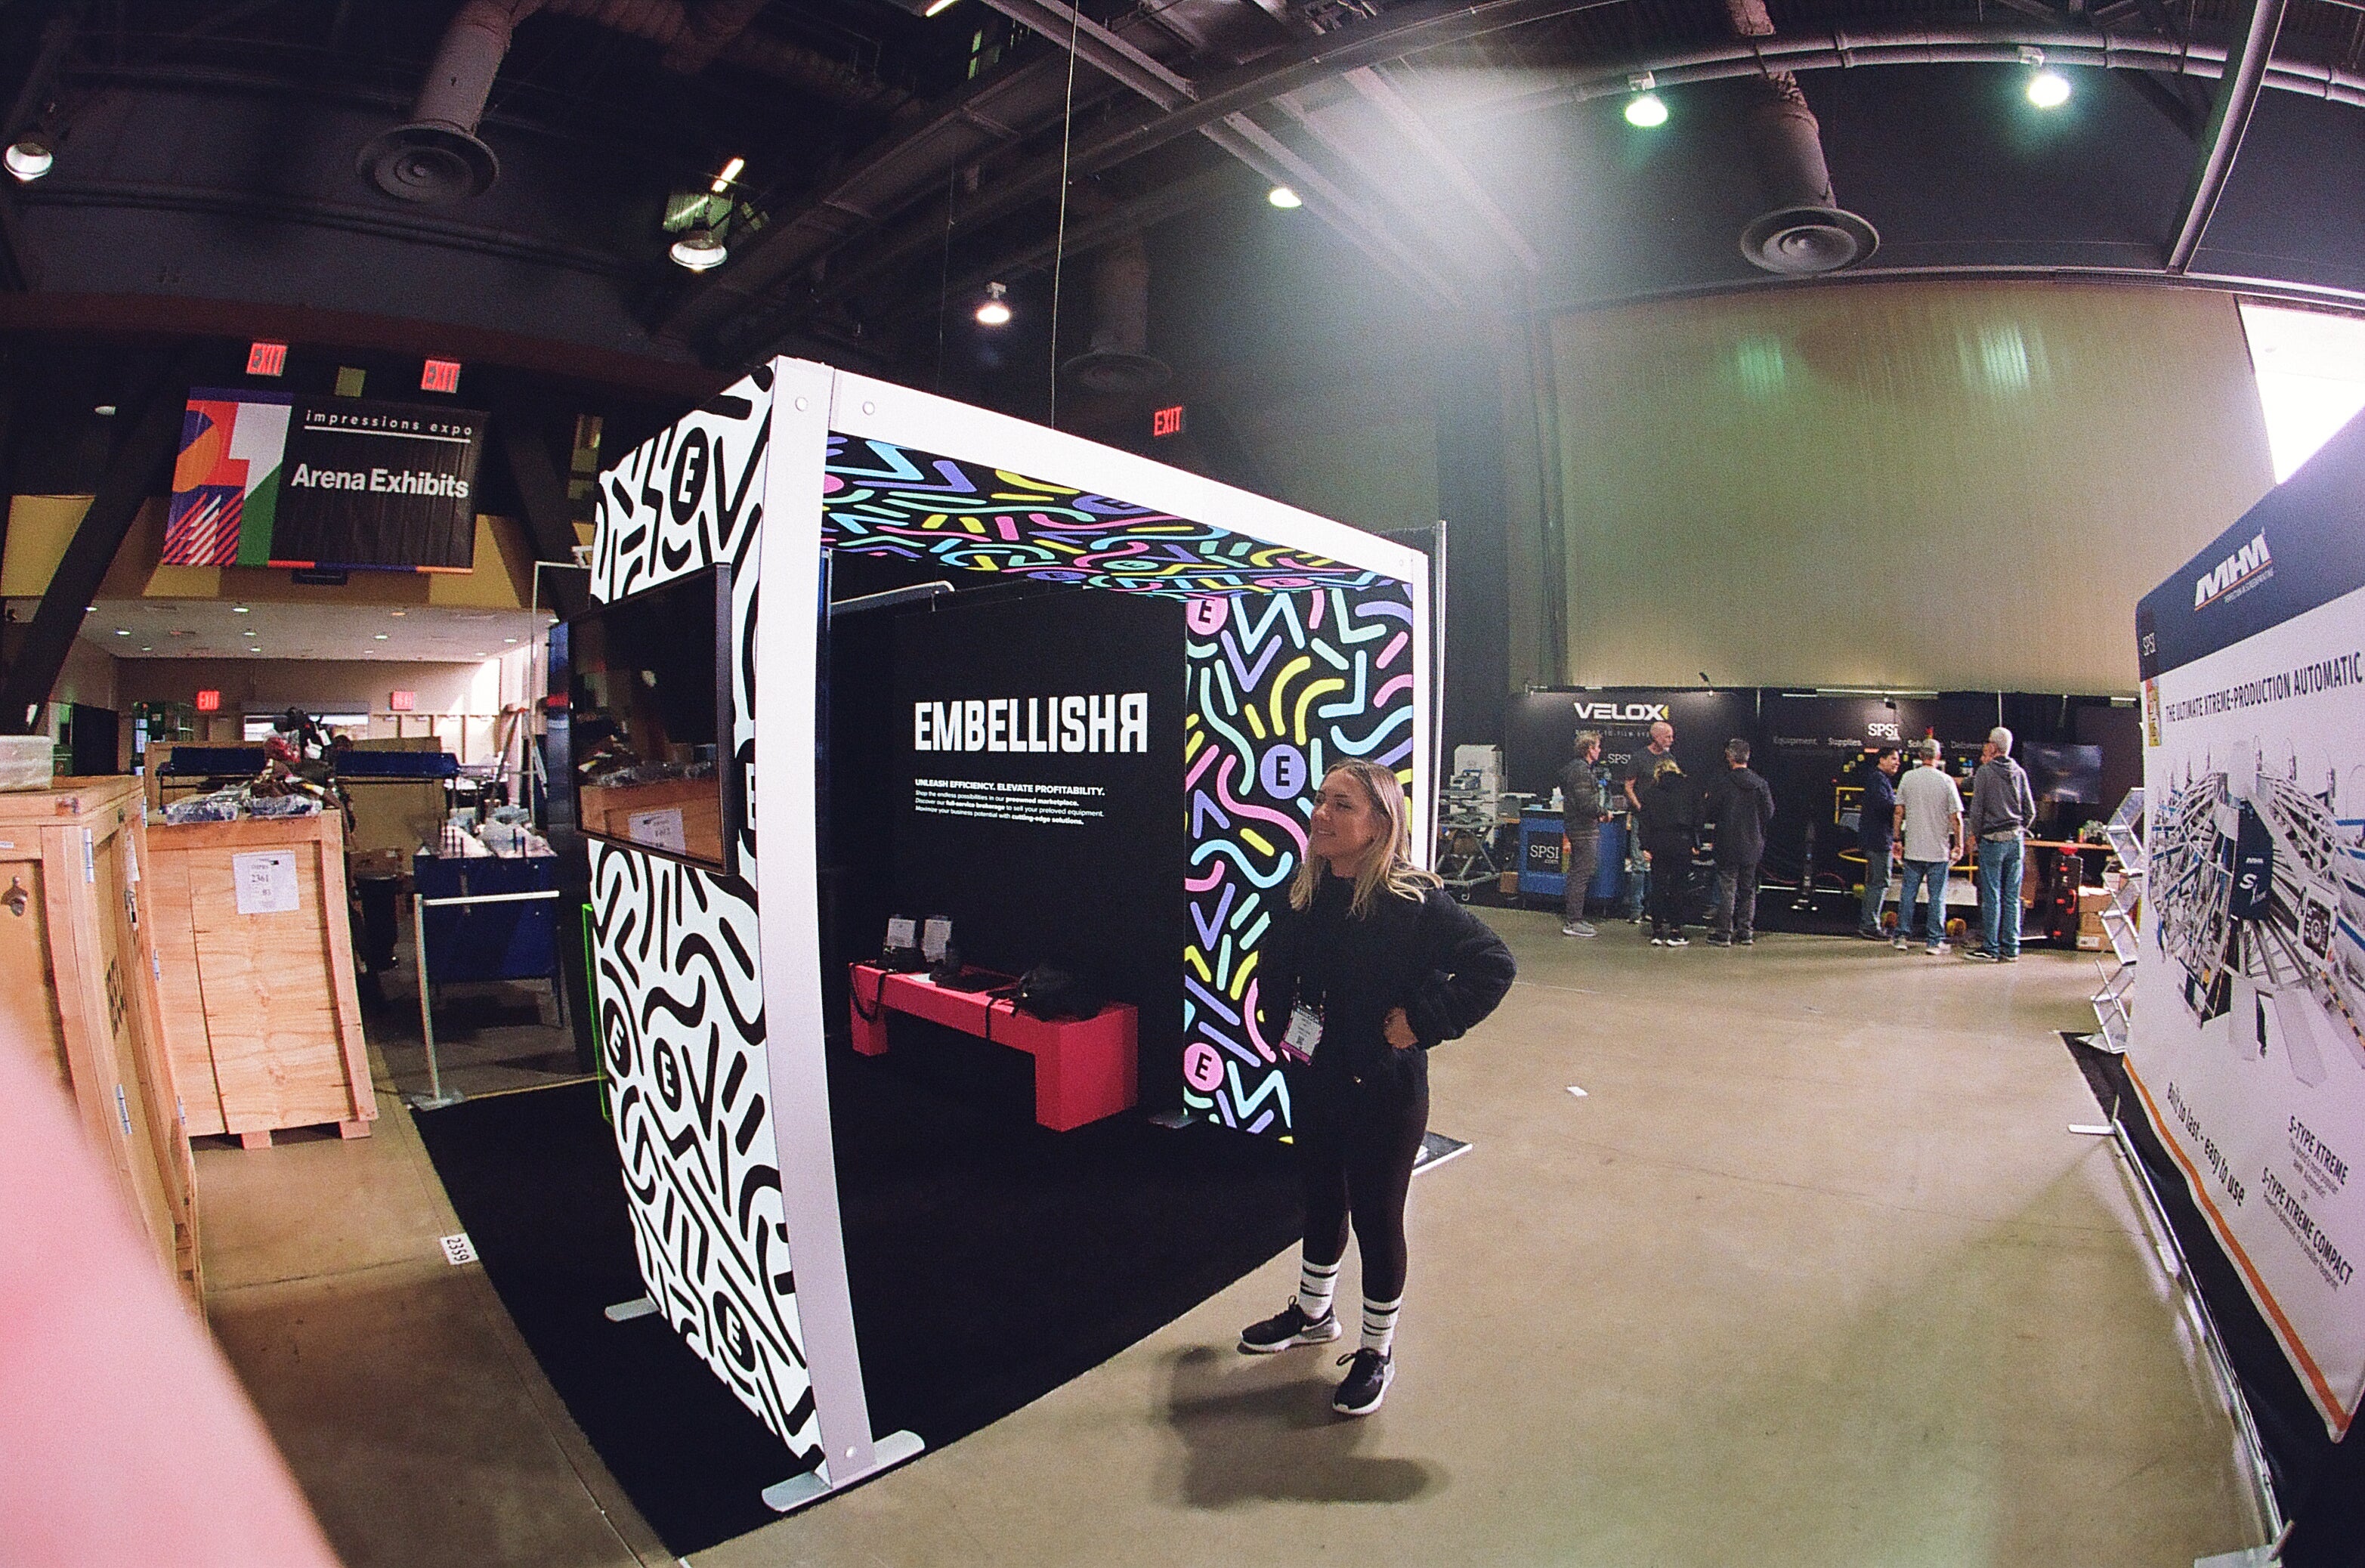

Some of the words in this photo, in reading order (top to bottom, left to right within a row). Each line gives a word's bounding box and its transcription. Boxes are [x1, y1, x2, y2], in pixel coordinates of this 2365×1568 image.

[246, 342, 287, 376] EXIT
[421, 359, 461, 392] EXIT
[306, 410, 419, 431] impressions
[429, 423, 472, 436] expo
[1154, 406, 1182, 436] EXIT
[291, 463, 366, 491] Arena
[369, 468, 469, 499] Exhibits
[678, 446, 700, 503] E
[2195, 533, 2272, 607] MHM
[1198, 601, 1215, 624] E
[2166, 704, 2175, 723] THE
[2177, 697, 2203, 722] ULTIMATE
[2204, 672, 2291, 717] XTREME-PRODUCTION
[2294, 651, 2363, 697] AUTOMATIC
[1574, 702, 1665, 721] VELOX
[915, 778, 948, 788] UNLEASH
[950, 780, 996, 790] EFFICIENCY.
[997, 783, 1033, 793] ELEVATE
[1035, 784, 1105, 796] PROFITABILITY.
[1275, 755, 1291, 787] E
[975, 802, 1005, 812] brokerage
[1067, 809, 1105, 817] equipment.
[1037, 798, 1080, 807] marketplace.
[1530, 845, 1560, 859] SPSI
[609, 1014, 624, 1062] E
[660, 1050, 675, 1098] E
[1195, 1052, 1212, 1081] E
[2186, 1108, 2200, 1142] last
[2204, 1138, 2221, 1175] easy
[2219, 1158, 2228, 1184] to
[2227, 1174, 2245, 1207] use
[2288, 1115, 2315, 1153] S-TYPE
[2314, 1140, 2348, 1186] XTREME
[2261, 1167, 2286, 1205] S-TYPE
[2284, 1193, 2314, 1240] XTREME
[2313, 1229, 2353, 1285] COMPACT
[447, 1237, 469, 1261] 2359
[725, 1306, 742, 1356] E
